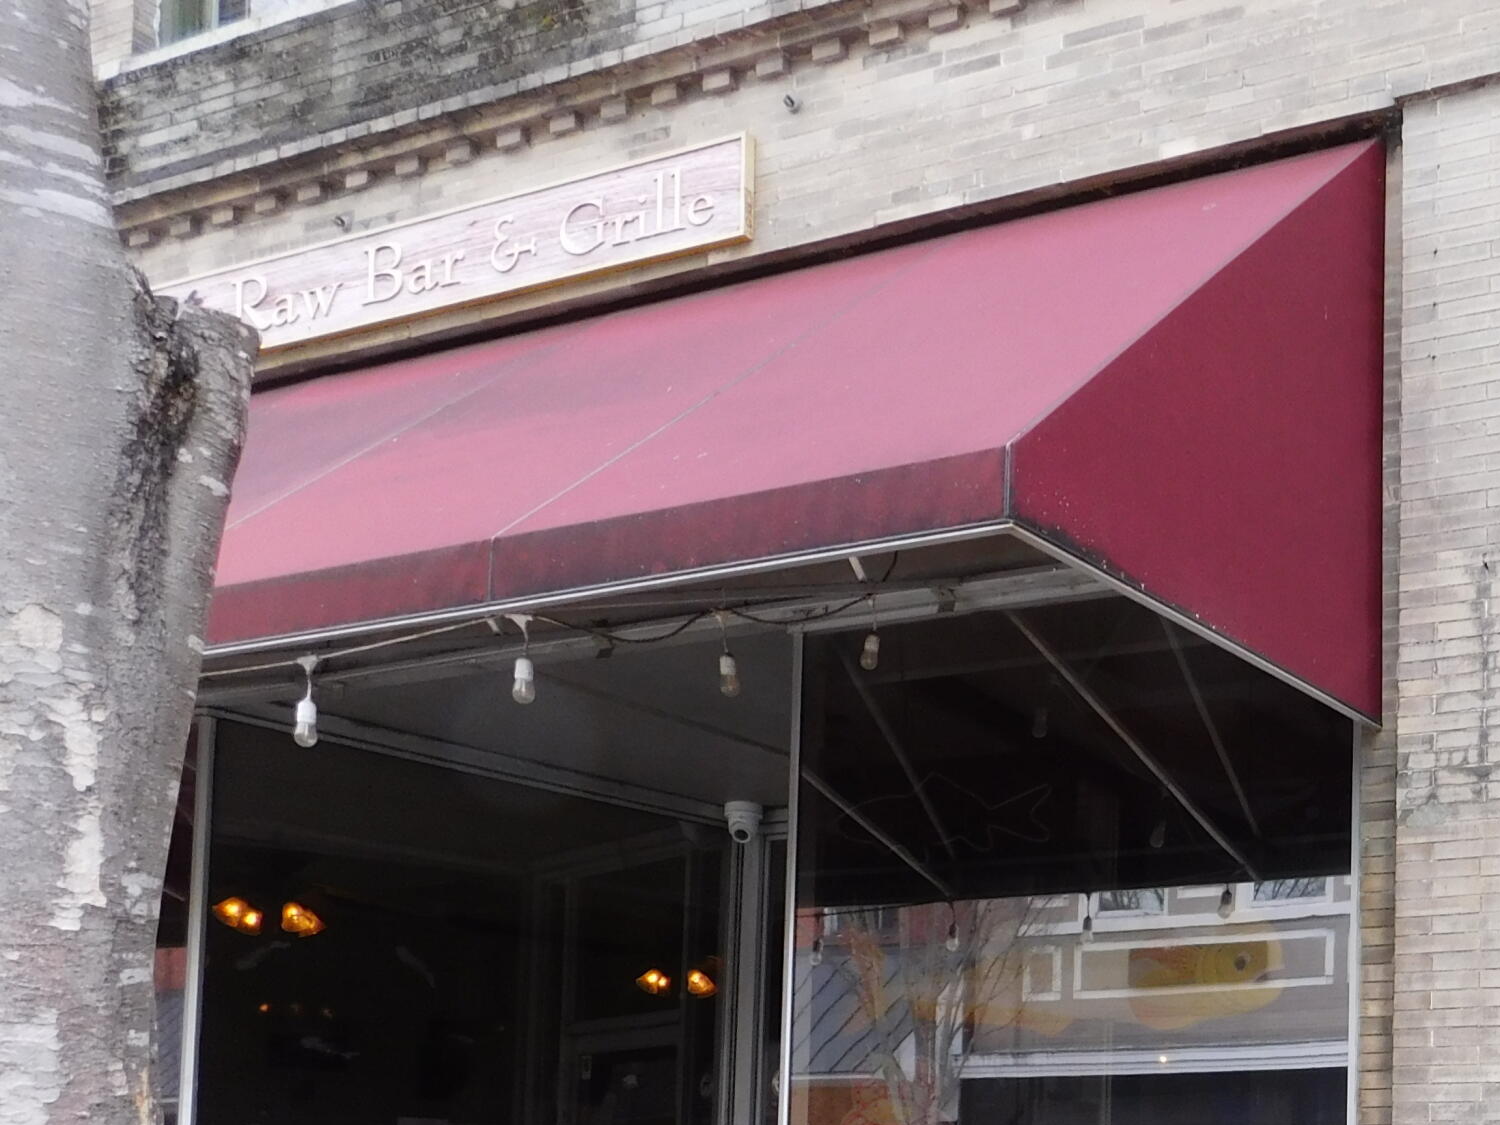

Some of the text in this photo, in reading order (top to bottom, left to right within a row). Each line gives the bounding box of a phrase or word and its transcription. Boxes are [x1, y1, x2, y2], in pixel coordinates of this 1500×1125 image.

[231, 167, 716, 332] Raw Bar & Grille
